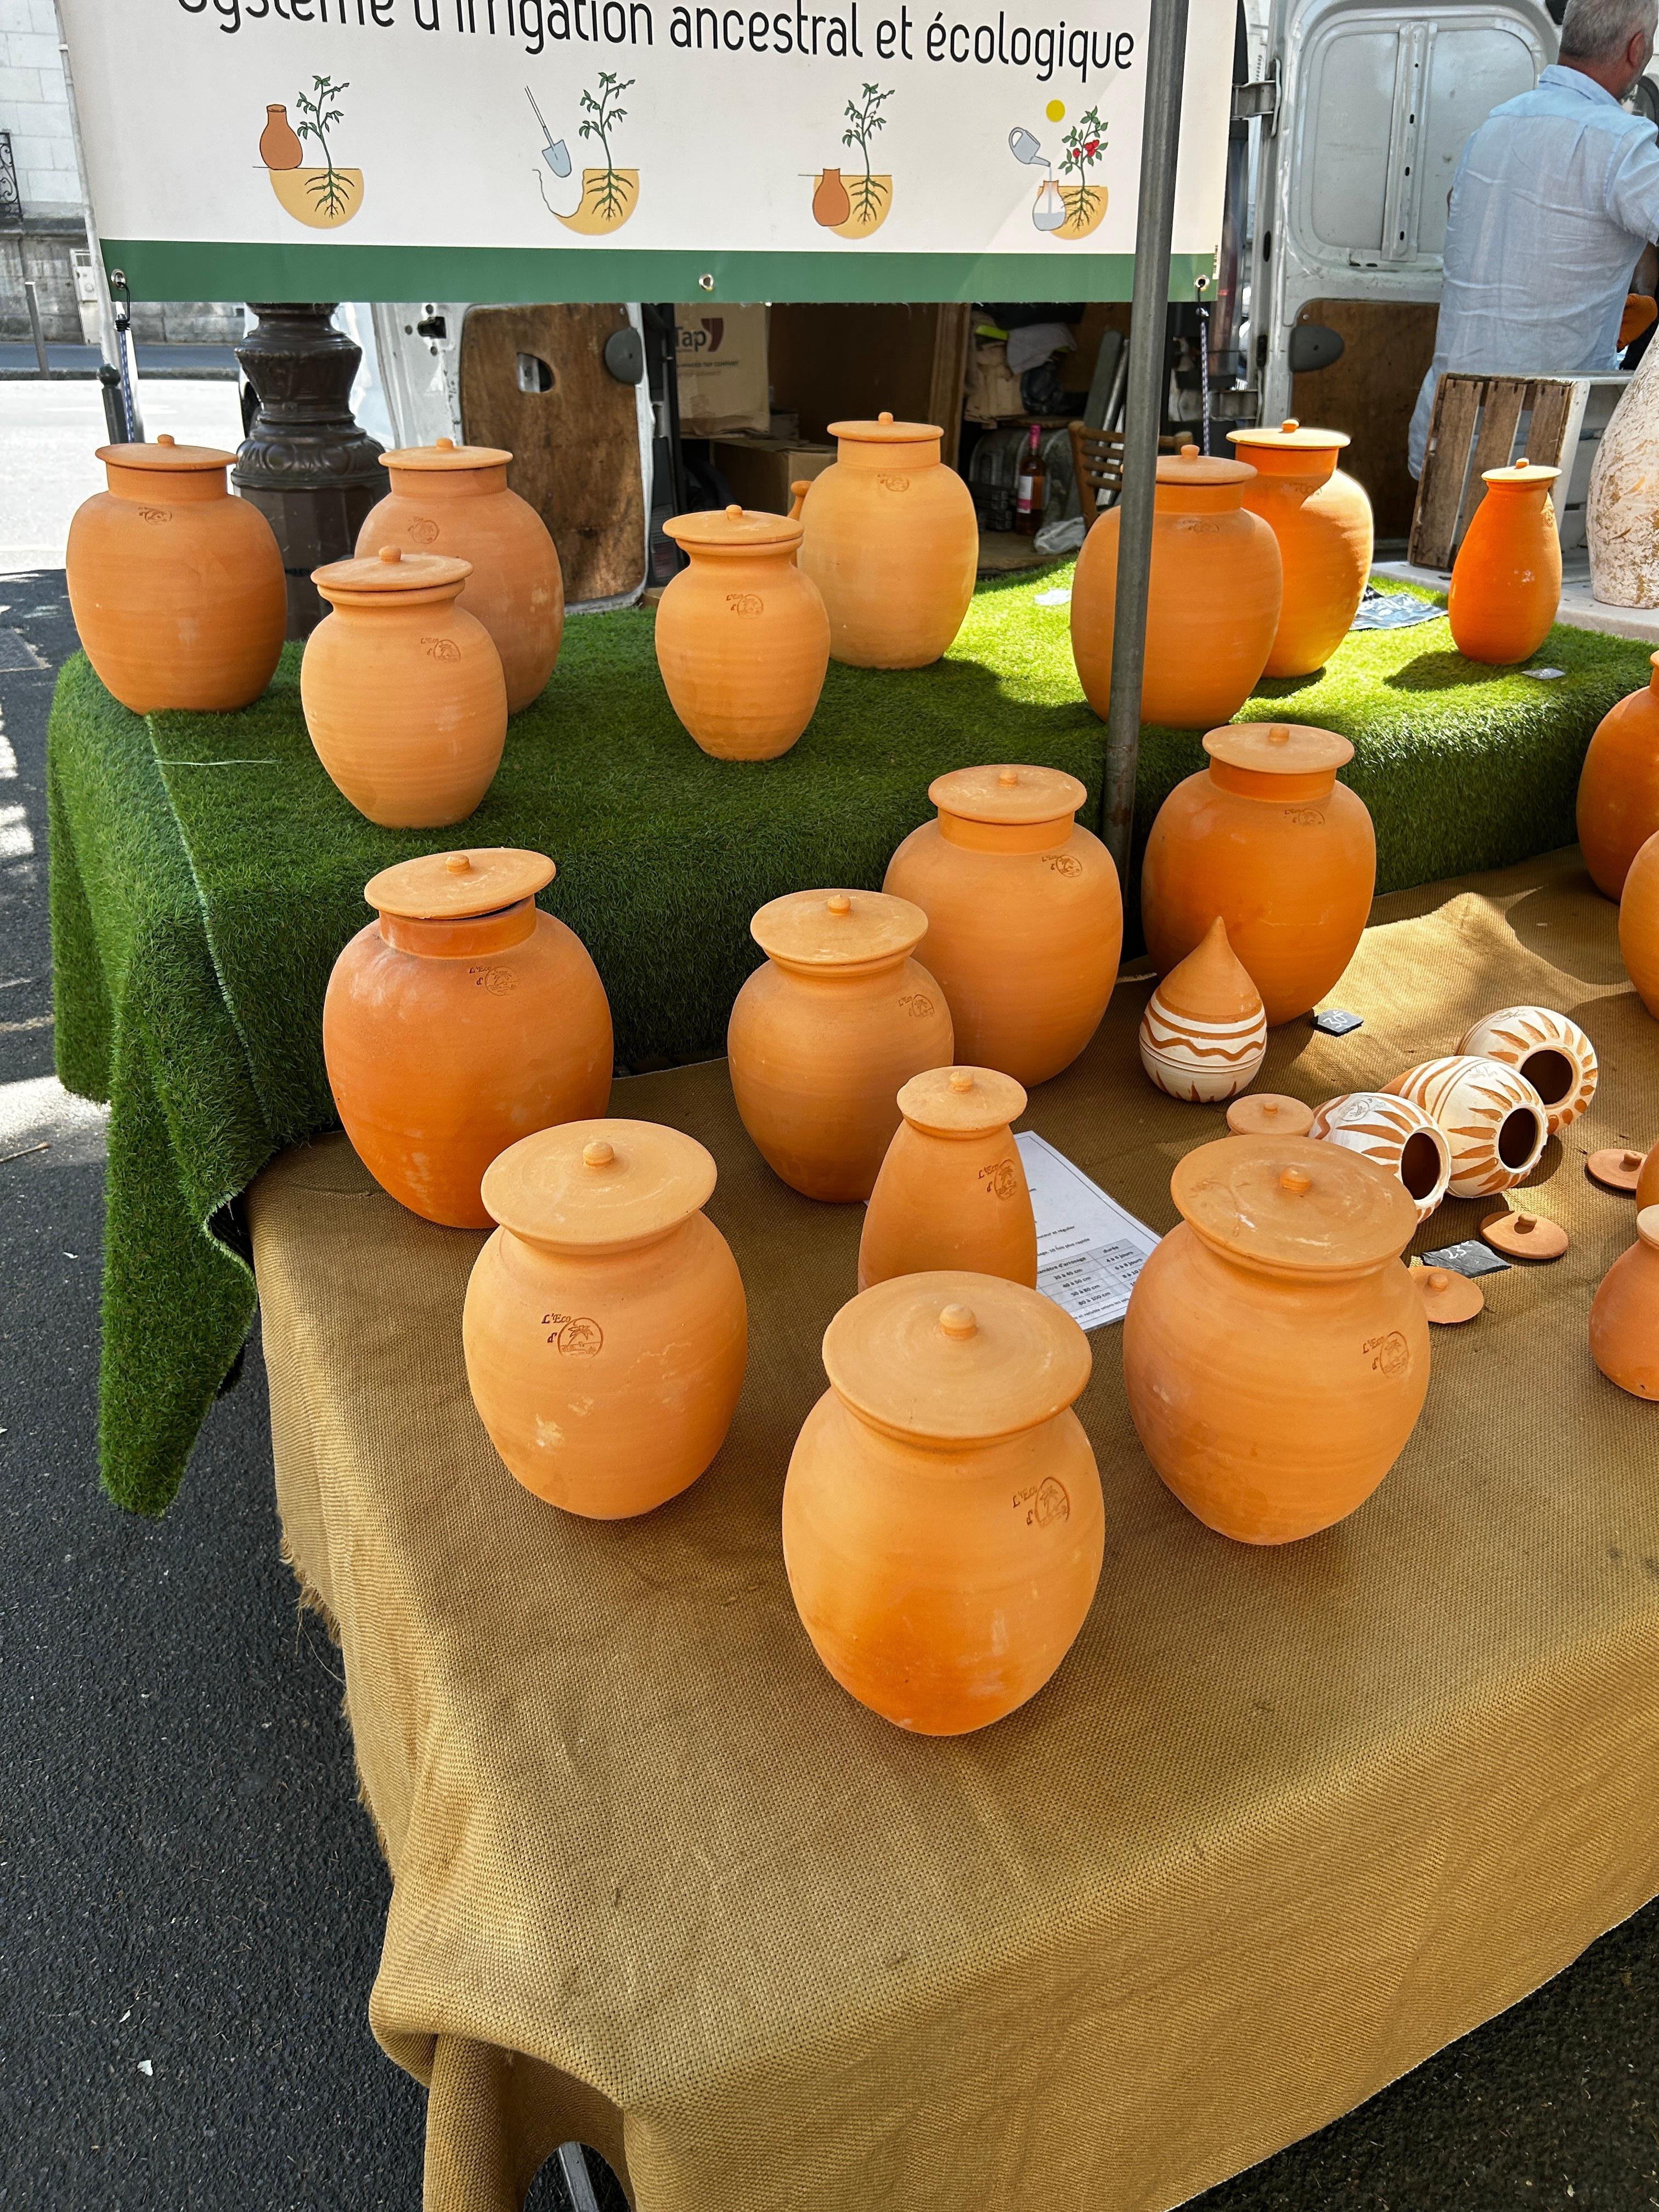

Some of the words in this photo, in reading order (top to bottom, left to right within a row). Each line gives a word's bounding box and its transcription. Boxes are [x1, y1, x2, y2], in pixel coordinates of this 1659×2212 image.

[414, 0, 653, 54] dirrigation
[670, 0, 863, 58] ancestral
[877, 5, 913, 60] et
[927, 12, 1134, 83] écologique
[1103, 1245, 1119, 1254] durée
[1119, 1251, 1134, 1259] jours
[1127, 1258, 1143, 1266] jours
[541, 1313, 572, 1324] L'Eco
[547, 1331, 557, 1343] d'
[1363, 1336, 1384, 1354] L'Eco
[1013, 1485, 1037, 1508] L'Eco
